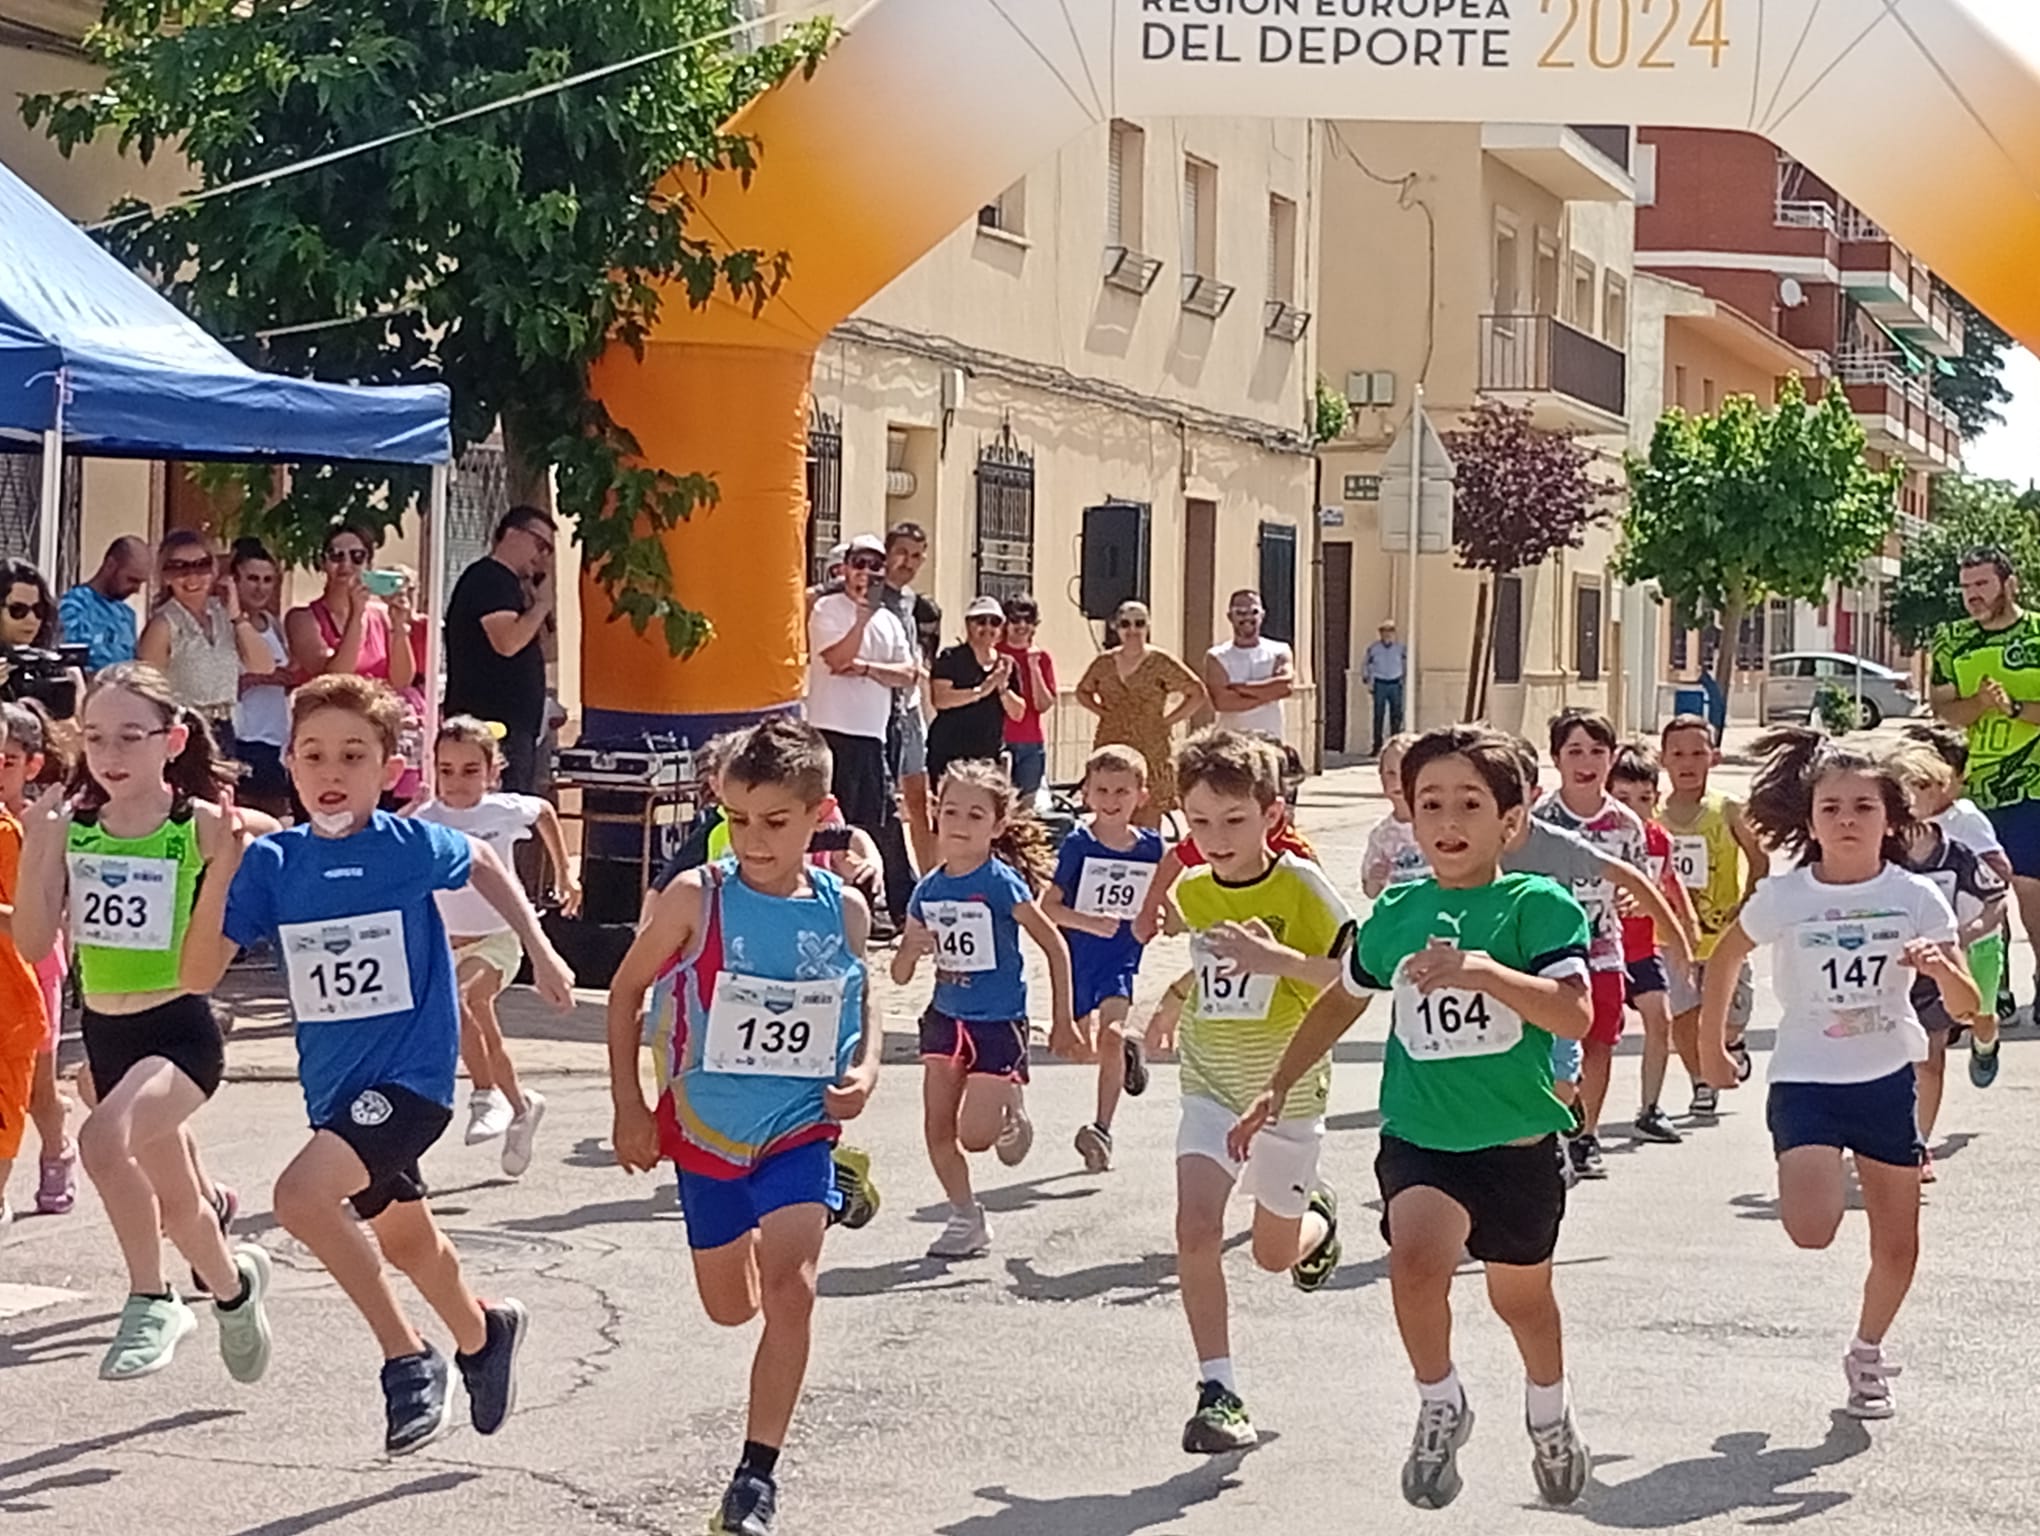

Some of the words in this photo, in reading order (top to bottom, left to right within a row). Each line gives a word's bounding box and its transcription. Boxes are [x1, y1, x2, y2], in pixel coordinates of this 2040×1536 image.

[1316, 0, 1510, 19] EUROPEA
[1143, 22, 1241, 62] DEL
[1260, 25, 1510, 67] DEPORTE
[1537, 0, 1730, 69] 2024
[83, 892, 147, 928] 263
[1095, 884, 1135, 906] 159
[309, 958, 383, 998] 152
[1821, 955, 1888, 990] 147
[1417, 993, 1491, 1035] 164
[737, 1017, 810, 1053] 139
